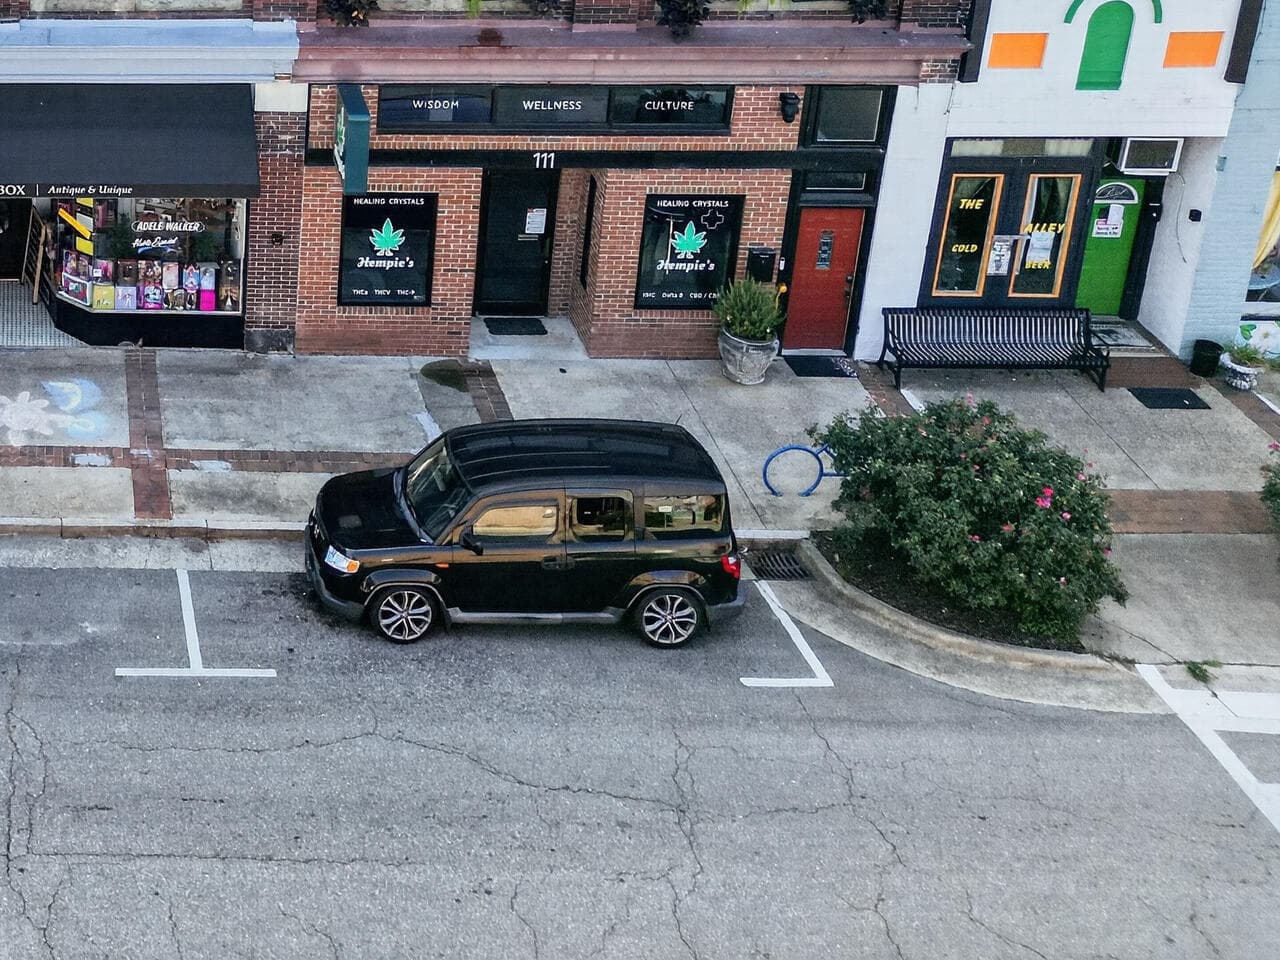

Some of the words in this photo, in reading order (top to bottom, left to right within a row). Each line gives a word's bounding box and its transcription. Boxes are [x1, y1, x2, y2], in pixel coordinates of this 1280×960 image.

[412, 100, 459, 109] WISDOM
[522, 100, 582, 110] WELLNESS
[644, 101, 694, 111] CULTURE
[532, 152, 555, 169] 111
[47, 185, 86, 196] Antique
[87, 185, 96, 194] &
[98, 185, 133, 195] Unique
[959, 199, 984, 209] THE
[136, 221, 164, 231] ADELE
[165, 221, 200, 231] WALKER
[1024, 223, 1066, 234] ALLEY
[951, 244, 978, 253] COLD
[357, 256, 415, 270] Hempie's
[656, 259, 716, 273] Hempie's
[1024, 260, 1052, 270] BEER
